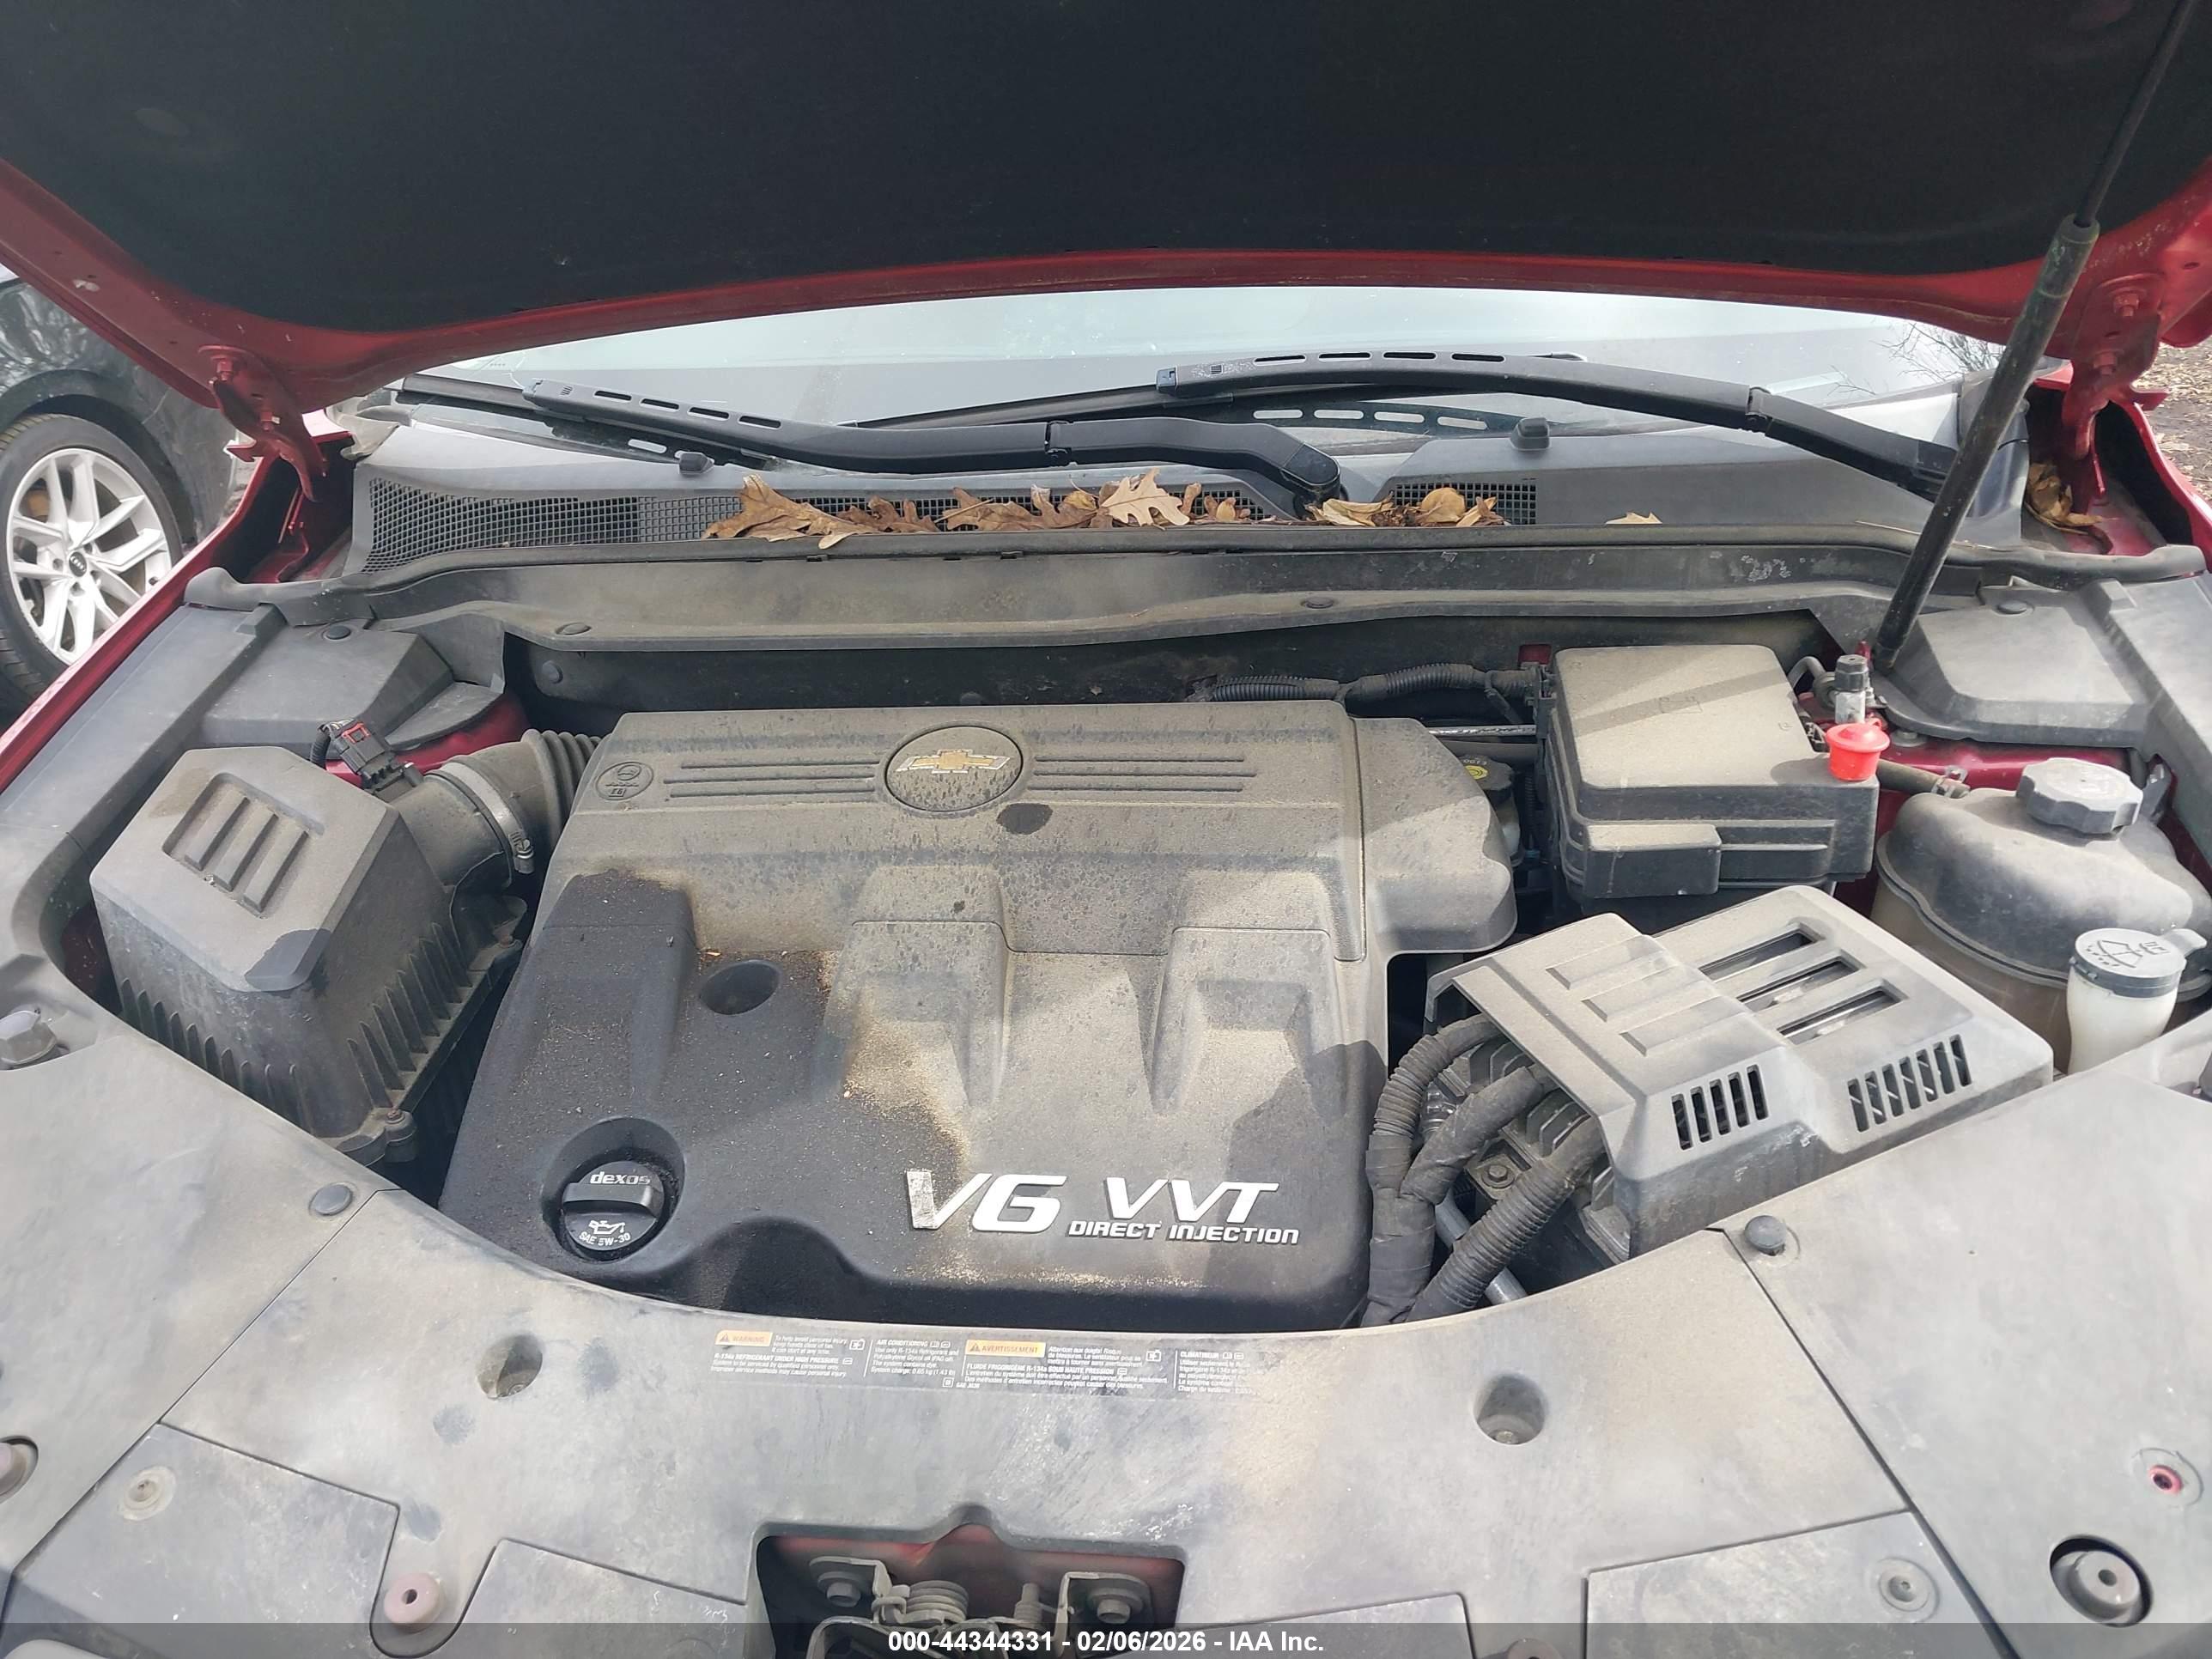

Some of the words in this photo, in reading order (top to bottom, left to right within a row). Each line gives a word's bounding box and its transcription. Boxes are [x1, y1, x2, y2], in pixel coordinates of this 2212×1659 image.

[590, 1171, 650, 1185] dexos
[906, 1170, 1067, 1233] V6
[1105, 1176, 1279, 1224] VVT
[579, 1231, 596, 1245] SAE
[598, 1233, 631, 1246] 5W-30
[1068, 1219, 1162, 1240] DIRECT
[1168, 1224, 1300, 1245] INJECTION
[981, 1345, 1038, 1354] AVERTISSEMENT
